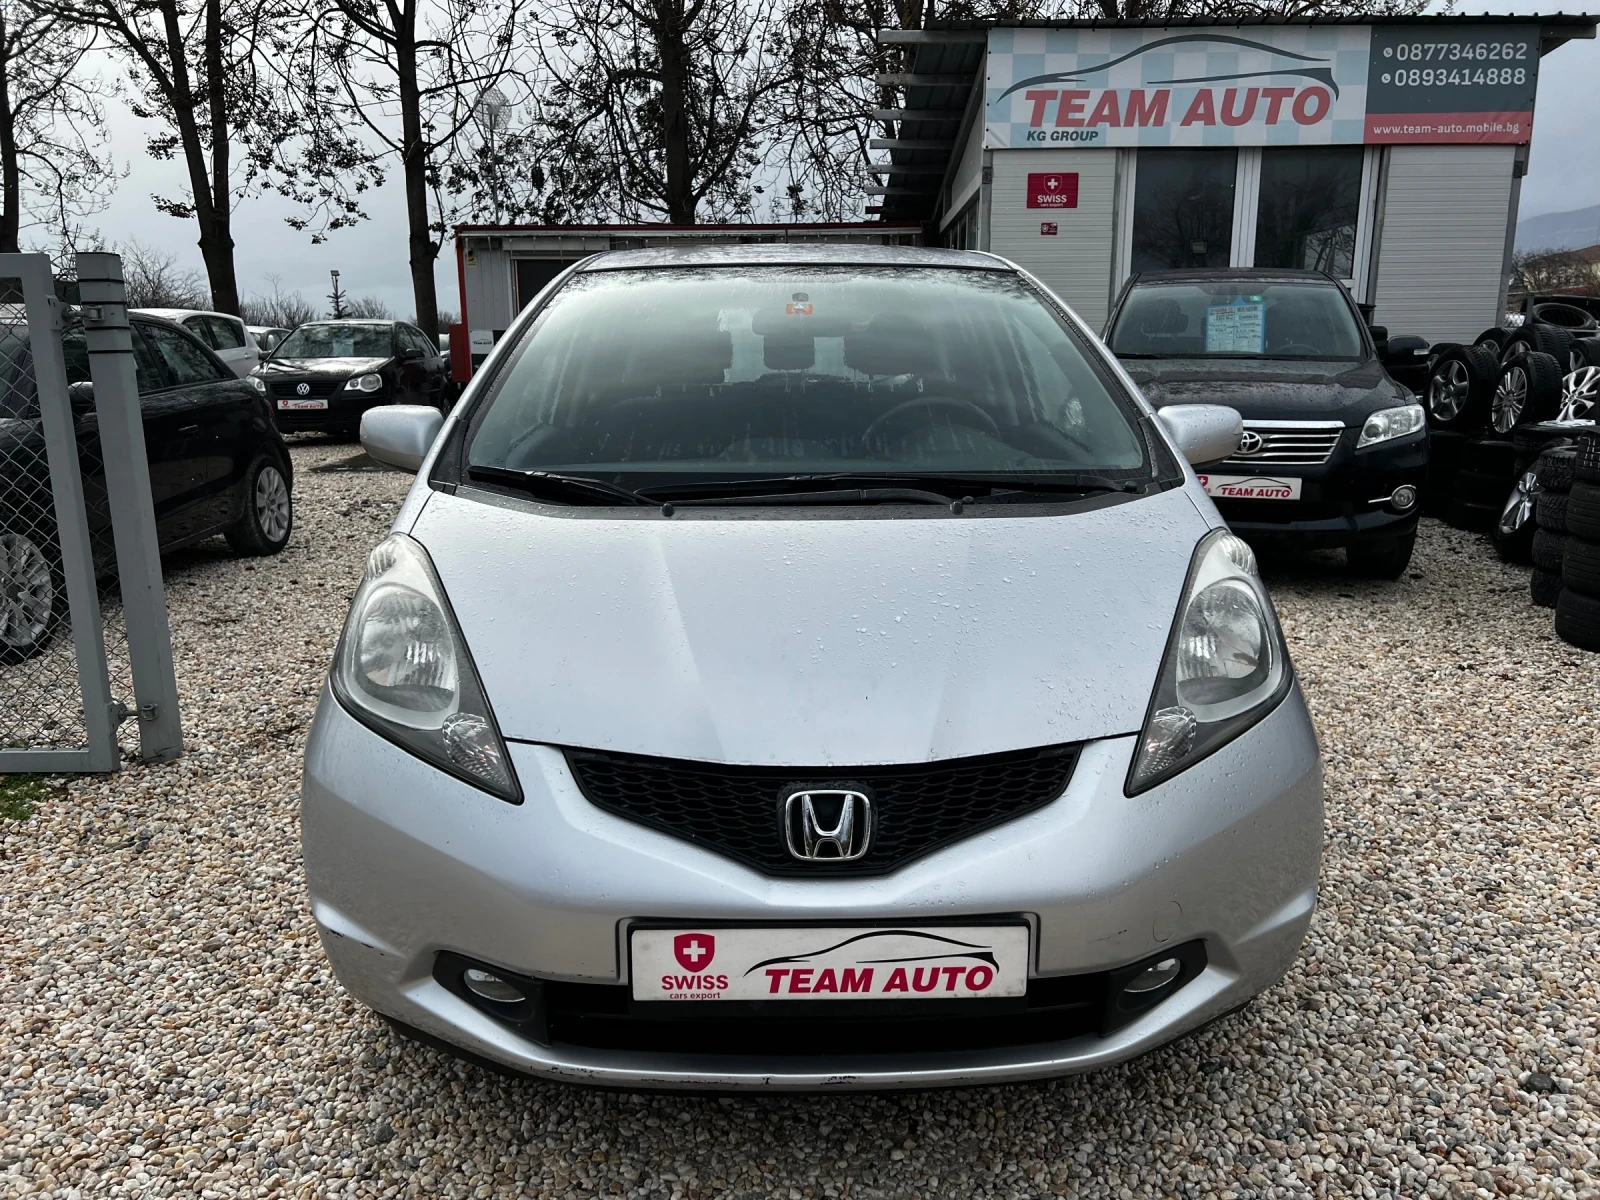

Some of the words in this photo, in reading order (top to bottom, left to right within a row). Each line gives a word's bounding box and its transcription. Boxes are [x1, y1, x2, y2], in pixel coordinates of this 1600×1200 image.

[1396, 43, 1528, 61] 0877346262
[1394, 68, 1526, 86] 0893414888
[1025, 89, 1171, 128] TEAM
[1179, 86, 1331, 127] AUTO
[1373, 122, 1520, 135] www.team-auto.mobile.bg
[1026, 130, 1047, 142] KG
[1050, 130, 1099, 142] GROUP
[1037, 194, 1067, 203] SWISS
[1221, 487, 1255, 497] TEAM
[1256, 488, 1291, 498] AUTO
[661, 974, 729, 990] SWISS
[765, 967, 874, 994] TEAM
[882, 965, 994, 993] AUTO
[690, 992, 721, 1001] export
